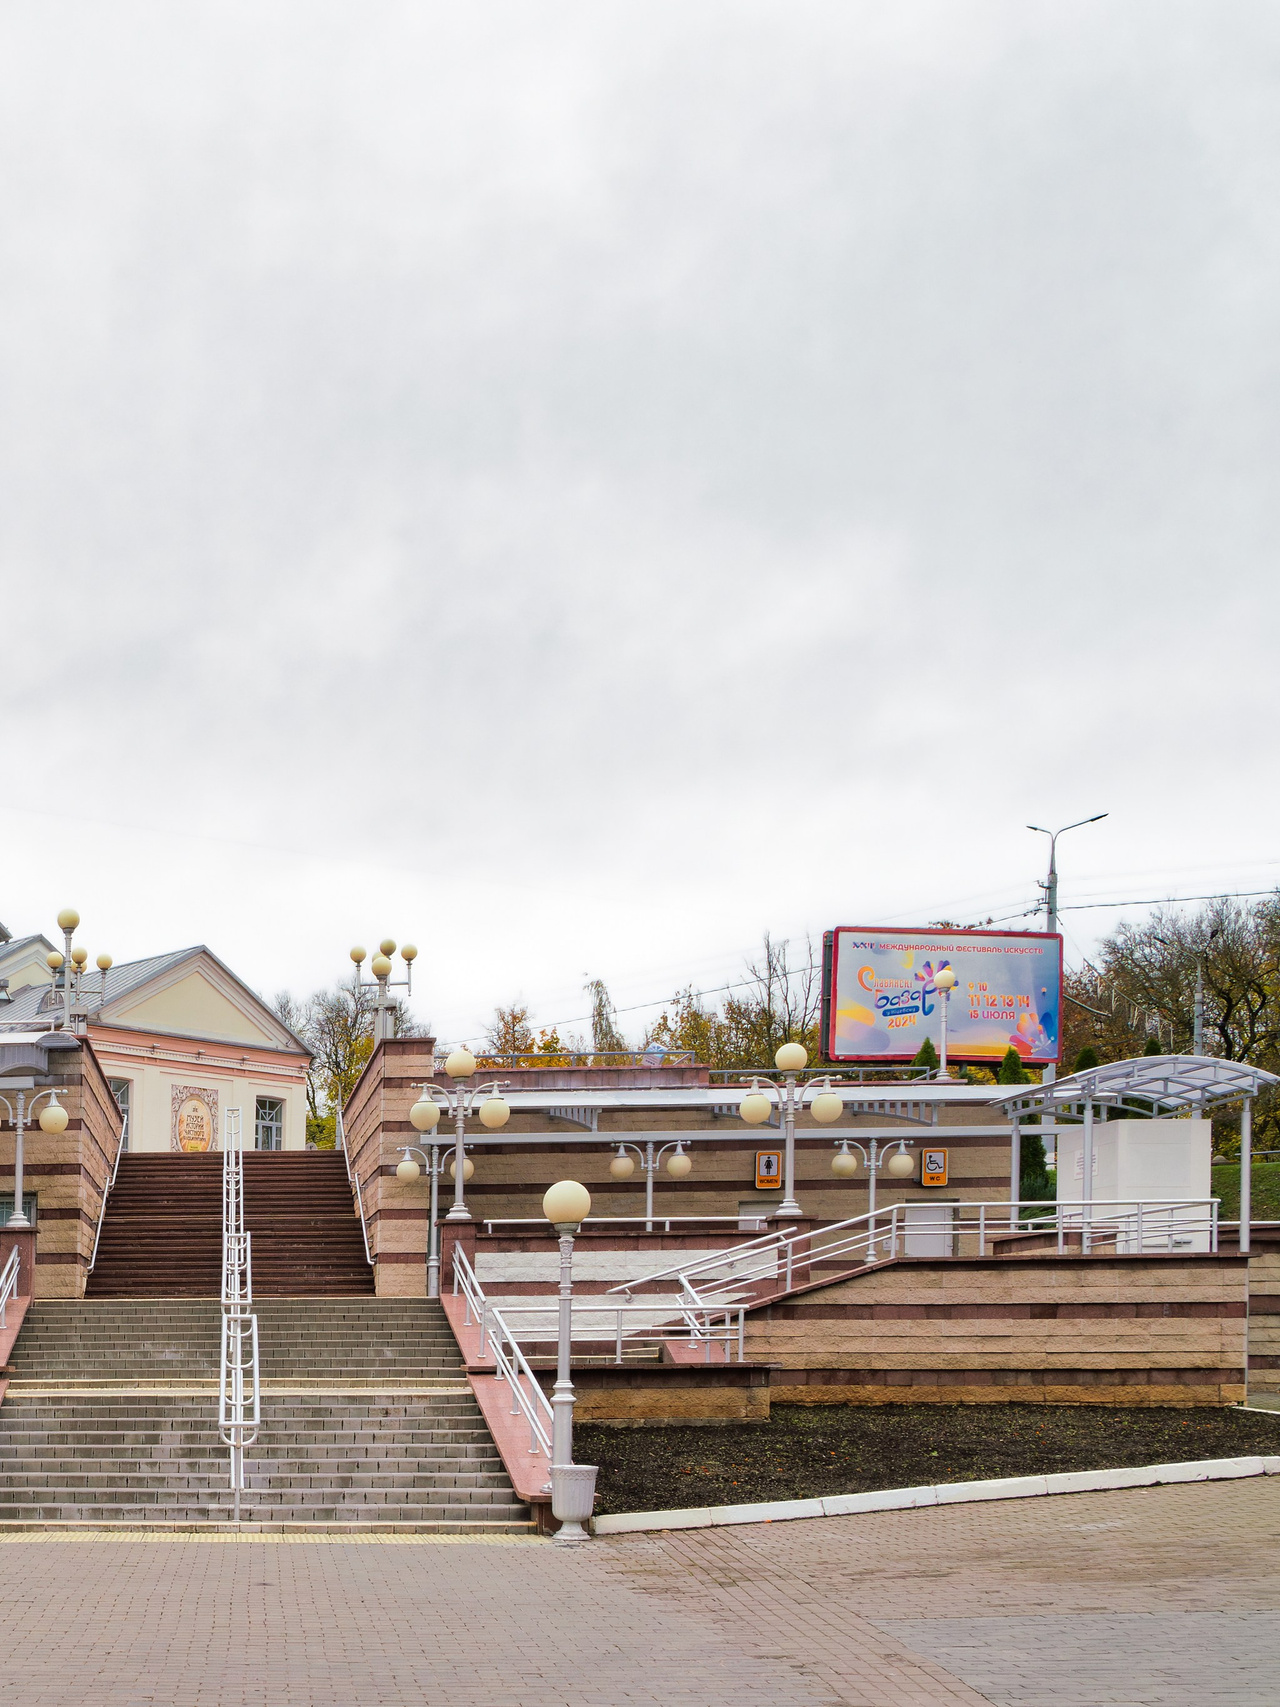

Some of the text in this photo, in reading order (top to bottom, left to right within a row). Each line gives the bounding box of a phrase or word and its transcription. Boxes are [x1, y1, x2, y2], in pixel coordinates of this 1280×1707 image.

[879, 943, 954, 952] МЕЖДУНАРОДНЫЙ
[955, 945, 1003, 954] ФЕСТИВАЛЬ
[1004, 947, 1043, 955] ИСКУССТВ
[968, 982, 988, 992] 9 10
[968, 994, 1030, 1008] 11 12 13 14
[968, 1010, 1016, 1020] 15 ИЮЛЯ
[887, 1015, 917, 1029] 2024
